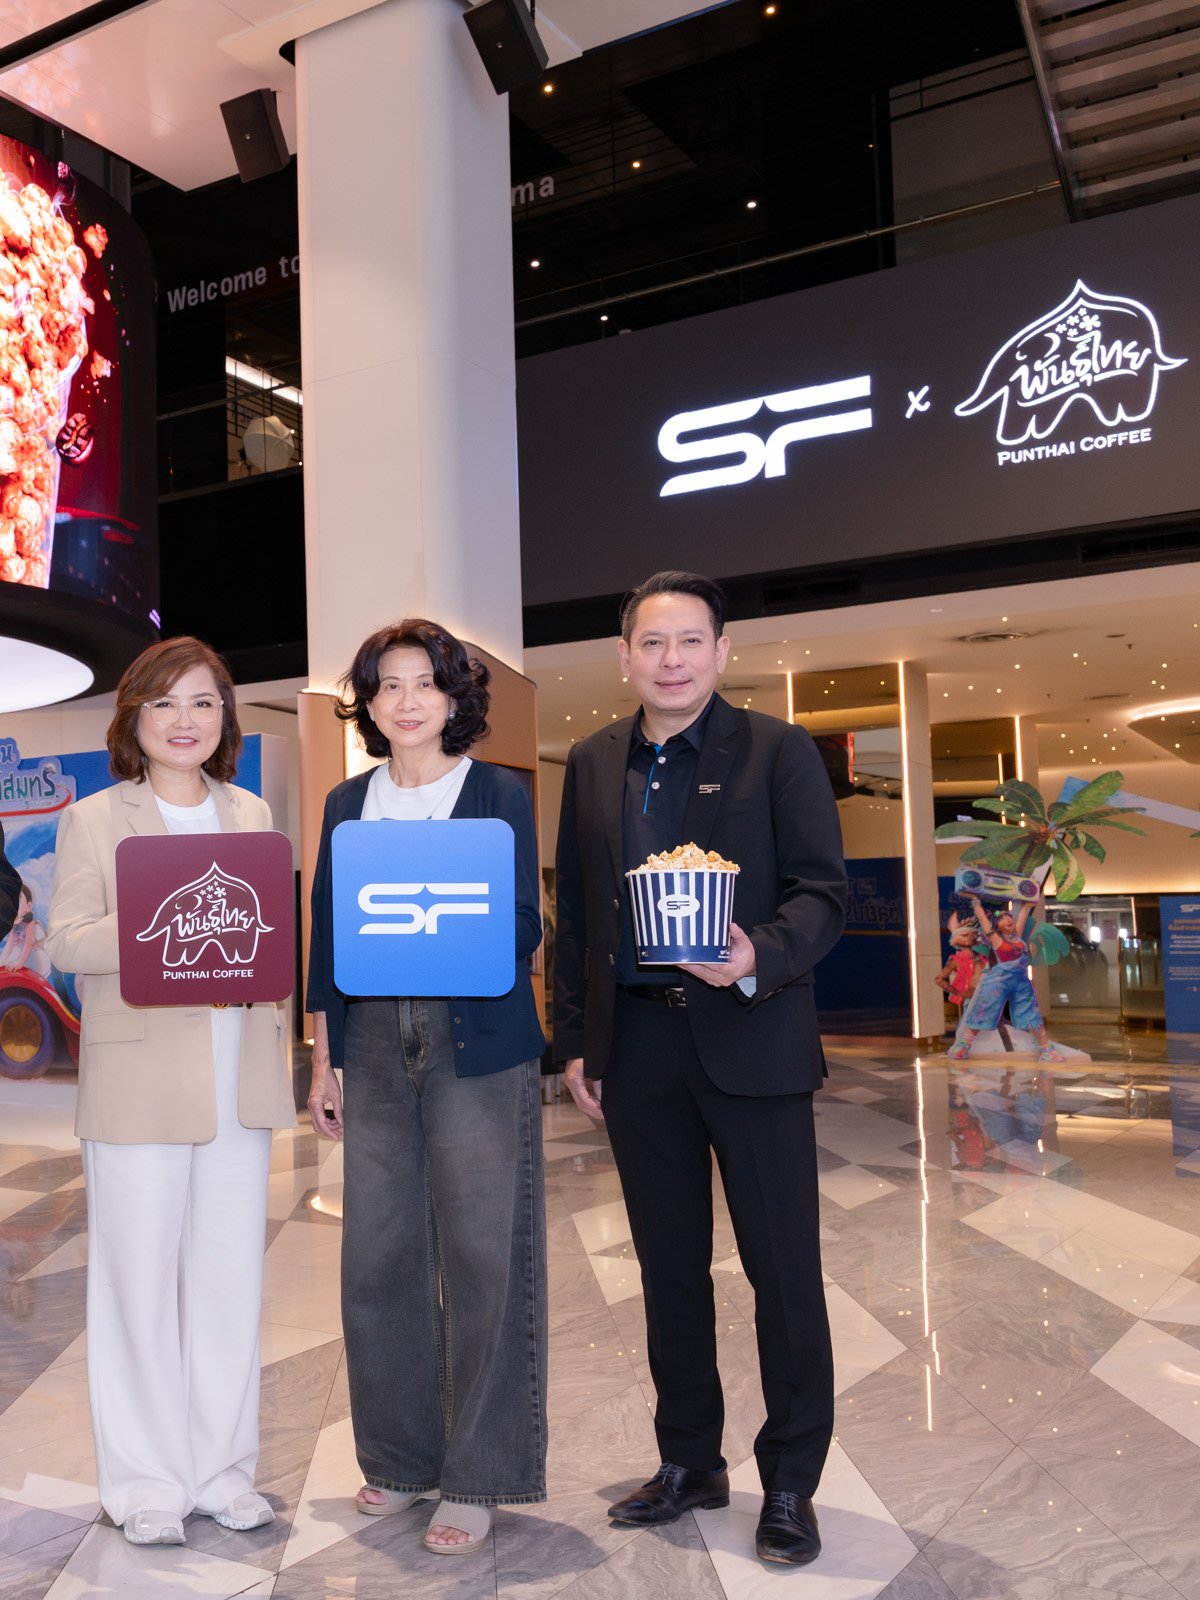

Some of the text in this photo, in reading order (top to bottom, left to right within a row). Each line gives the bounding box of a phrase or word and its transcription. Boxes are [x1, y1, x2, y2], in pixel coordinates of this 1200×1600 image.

[511, 176, 554, 207] ma
[167, 266, 267, 313] Welcome
[1009, 330, 1152, 399] พันธุ์ไทย
[657, 374, 873, 497] SF
[997, 428, 1153, 466] PUNTHAI COFFEE
[171, 898, 256, 938] พันธุ์ไทย
[357, 882, 489, 934] SF
[666, 900, 690, 910] SF
[163, 968, 254, 981] PUNTHAI COFFEE
